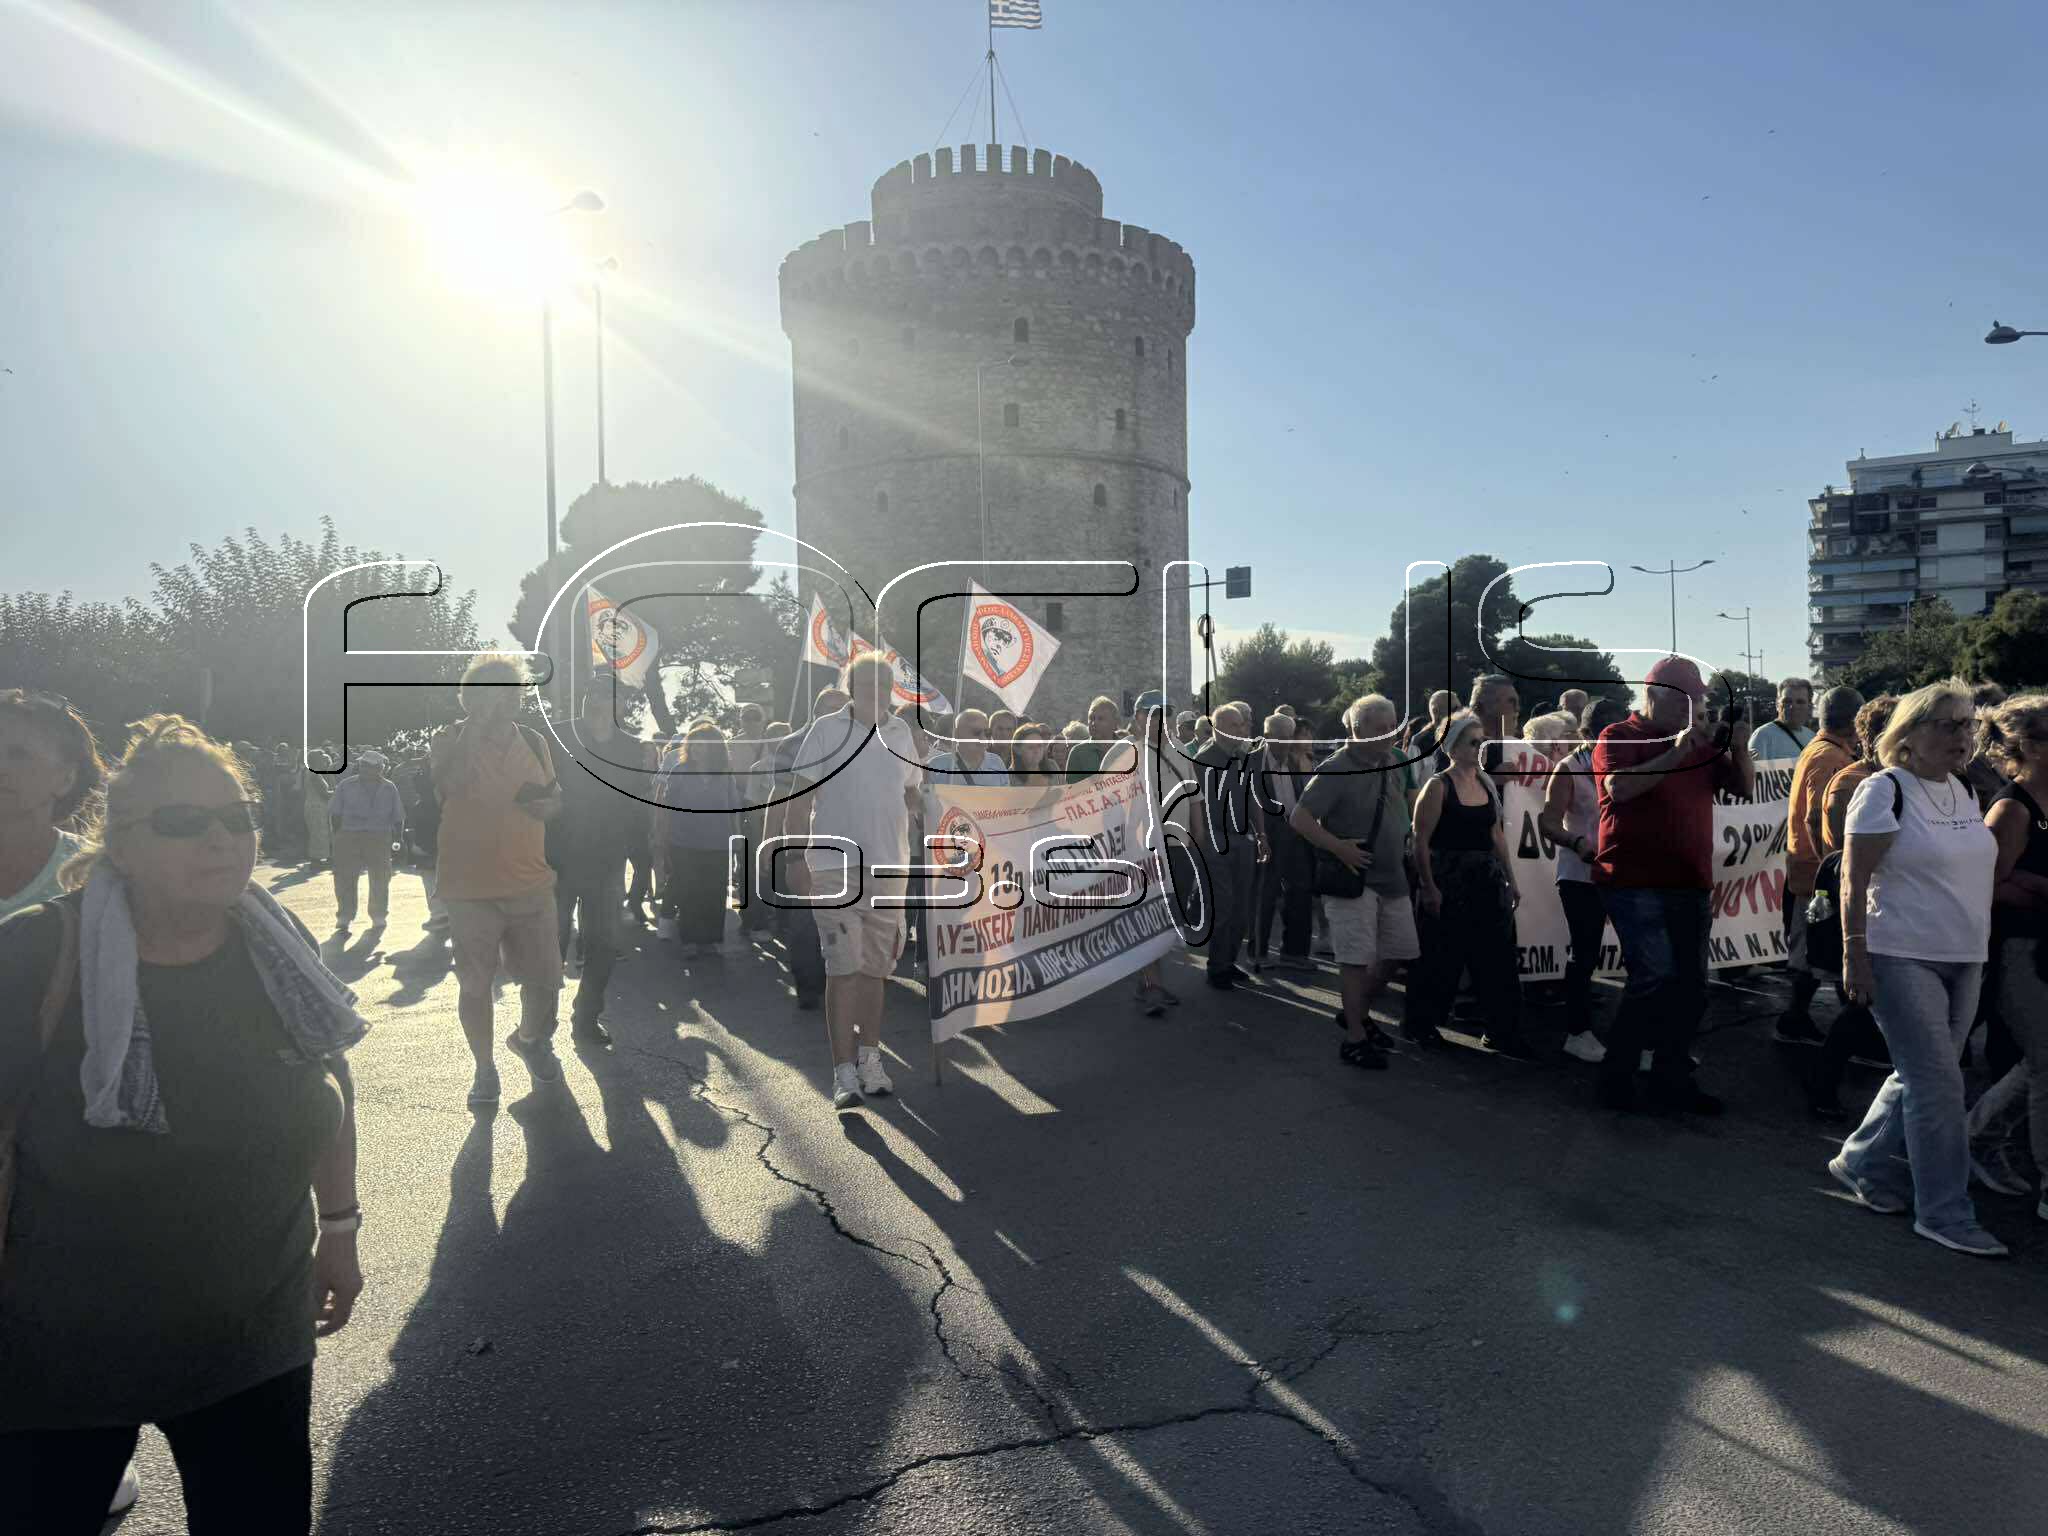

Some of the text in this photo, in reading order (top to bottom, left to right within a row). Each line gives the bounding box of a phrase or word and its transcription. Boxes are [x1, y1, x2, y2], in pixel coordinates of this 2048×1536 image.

[936, 910, 1016, 960] ΑΥΞΗΣΕΙΣ
[1769, 930, 1788, 955] Κ
[941, 960, 1036, 1014] ΔΗΜΟΣΙΑ
